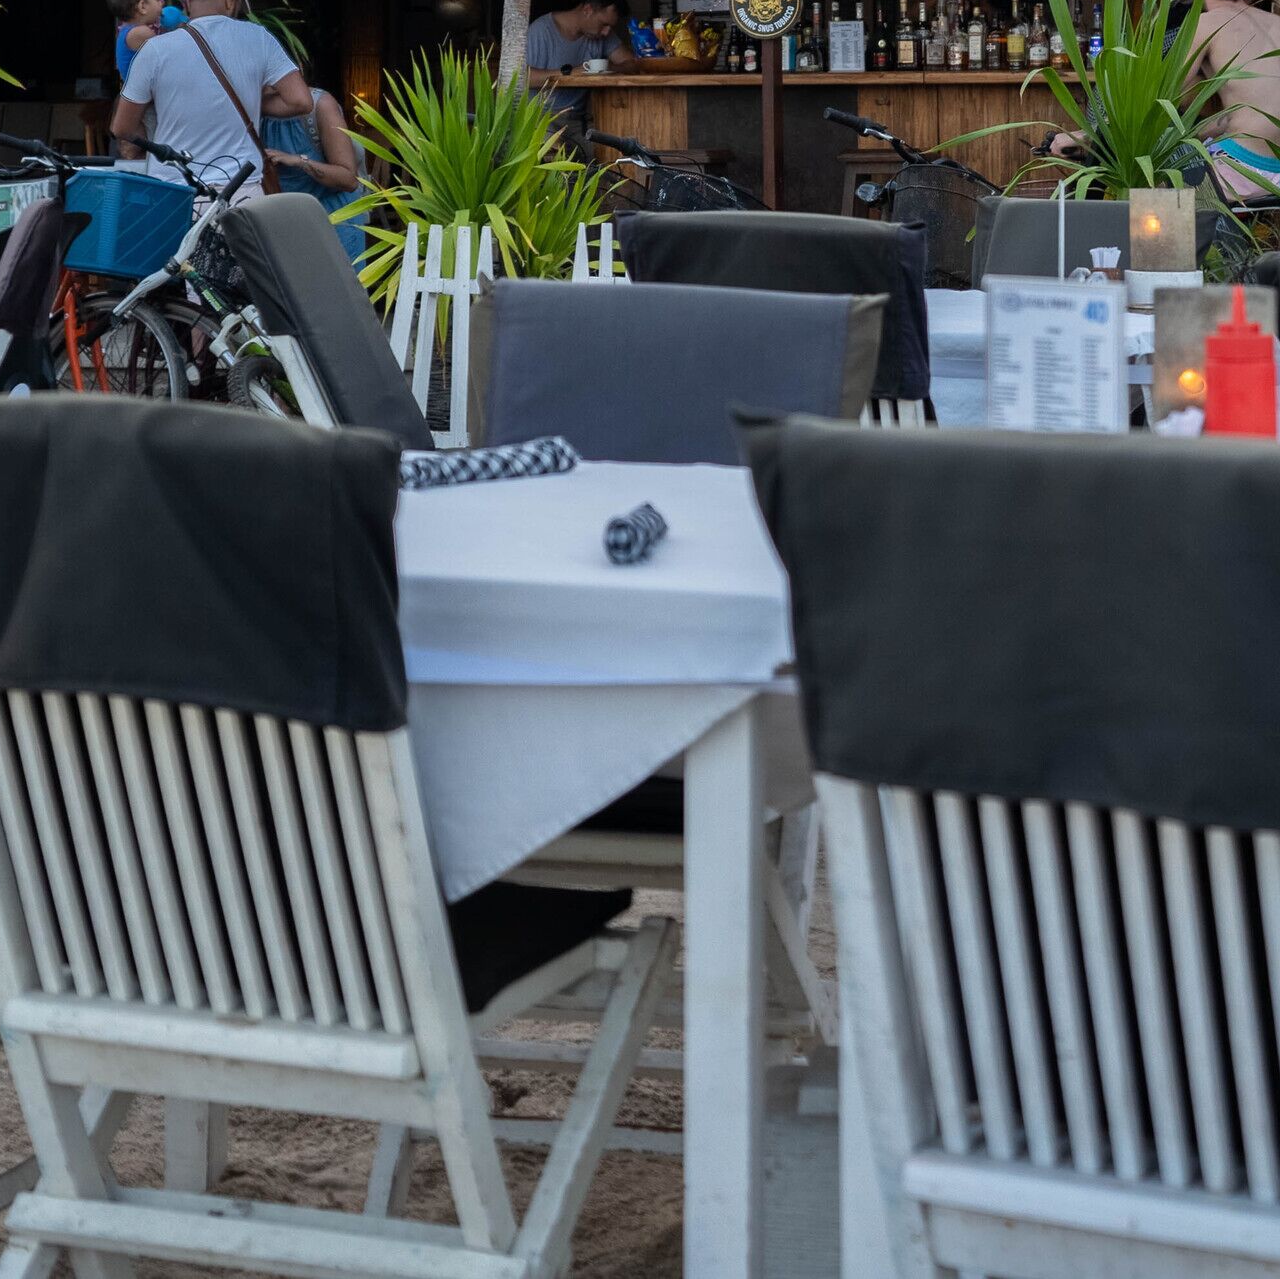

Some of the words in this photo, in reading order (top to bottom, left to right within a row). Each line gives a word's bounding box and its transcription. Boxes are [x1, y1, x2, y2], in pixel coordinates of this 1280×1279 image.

[736, 7, 759, 31] ORGANIC
[757, 23, 775, 32] SNUS
[774, 5, 795, 30] TOBACCO
